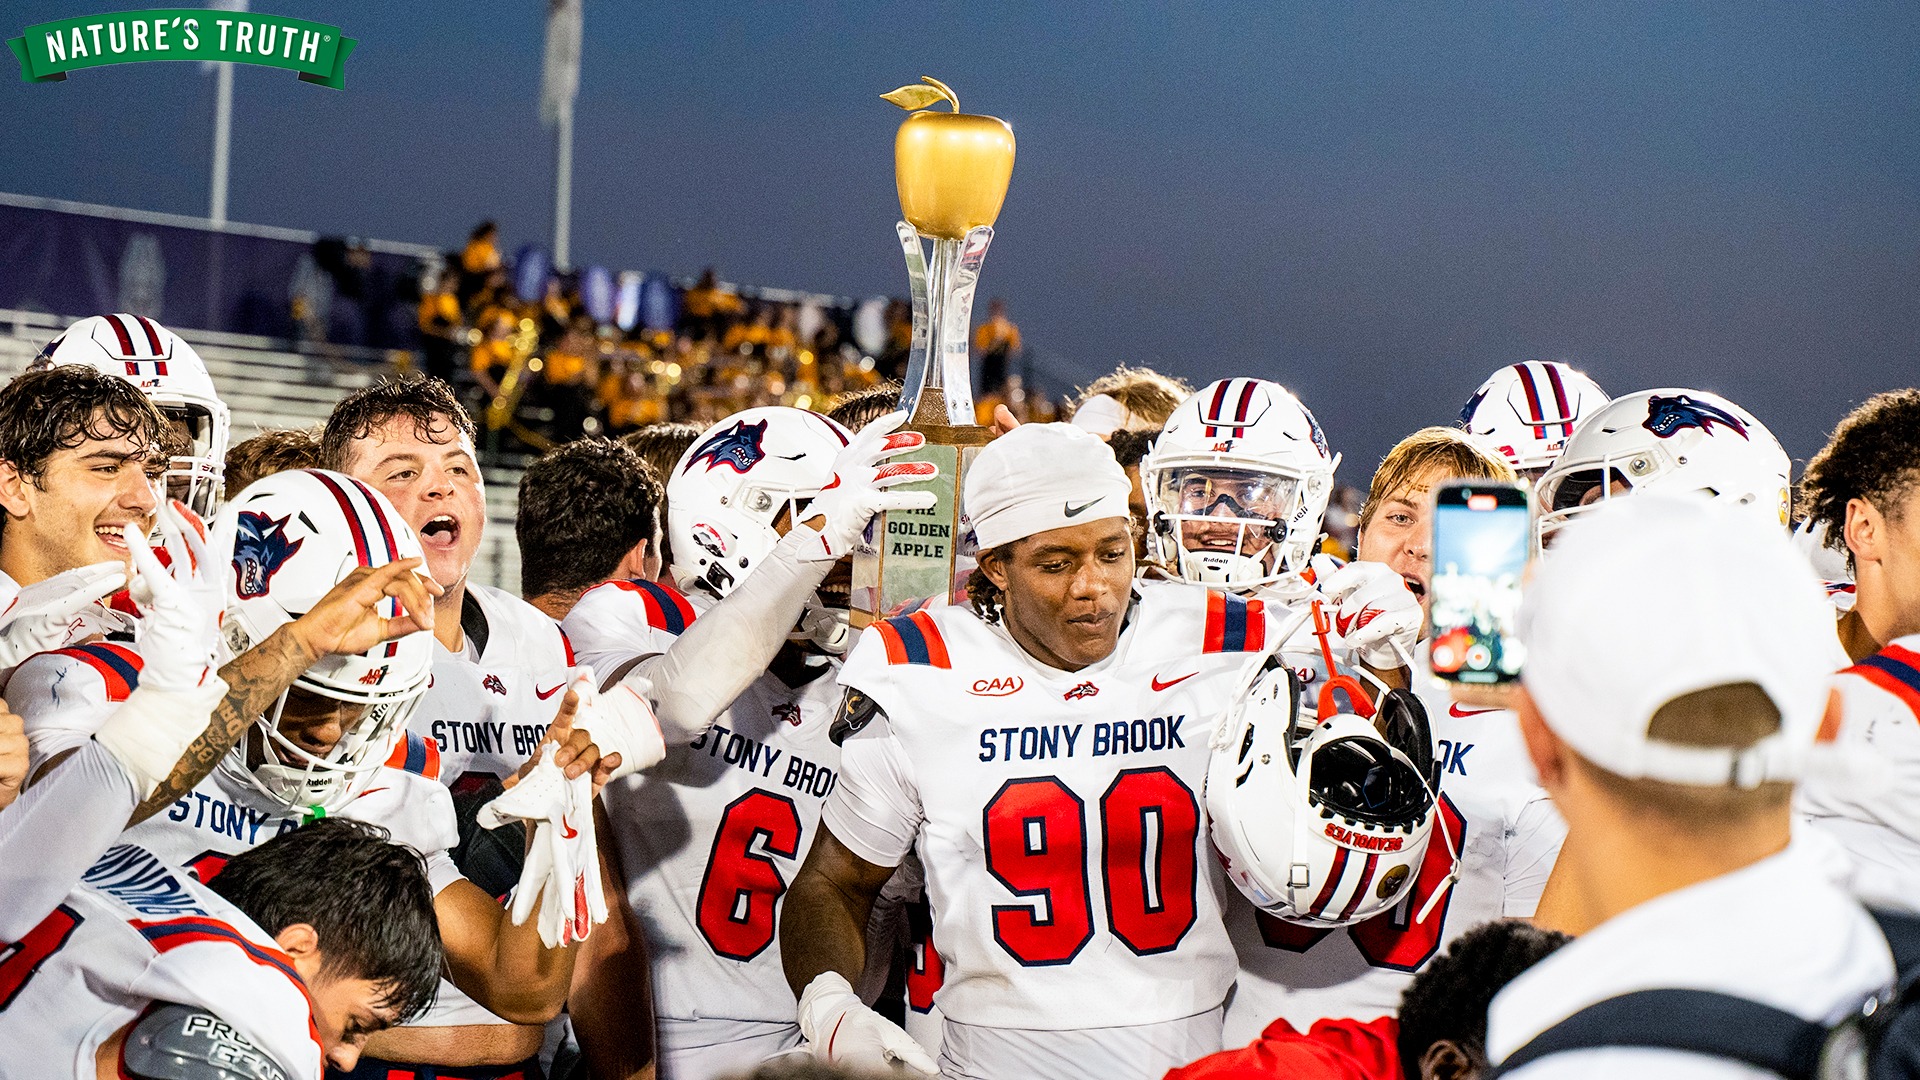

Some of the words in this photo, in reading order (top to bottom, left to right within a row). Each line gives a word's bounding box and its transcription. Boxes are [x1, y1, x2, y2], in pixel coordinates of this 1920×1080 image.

[888, 521, 950, 538] GOLDEN
[892, 542, 944, 559] APPLE
[1203, 557, 1229, 565] Riddell
[971, 676, 1017, 693] CAA
[431, 720, 506, 754] STONY
[512, 724, 552, 756] BRO
[979, 724, 1083, 762] STONY
[1092, 715, 1185, 757] BROOK
[306, 777, 333, 787] Riddell
[168, 791, 271, 845] STONY
[1324, 823, 1403, 852] SEAWOLVES
[695, 786, 802, 963] 6
[982, 765, 1200, 967] 90
